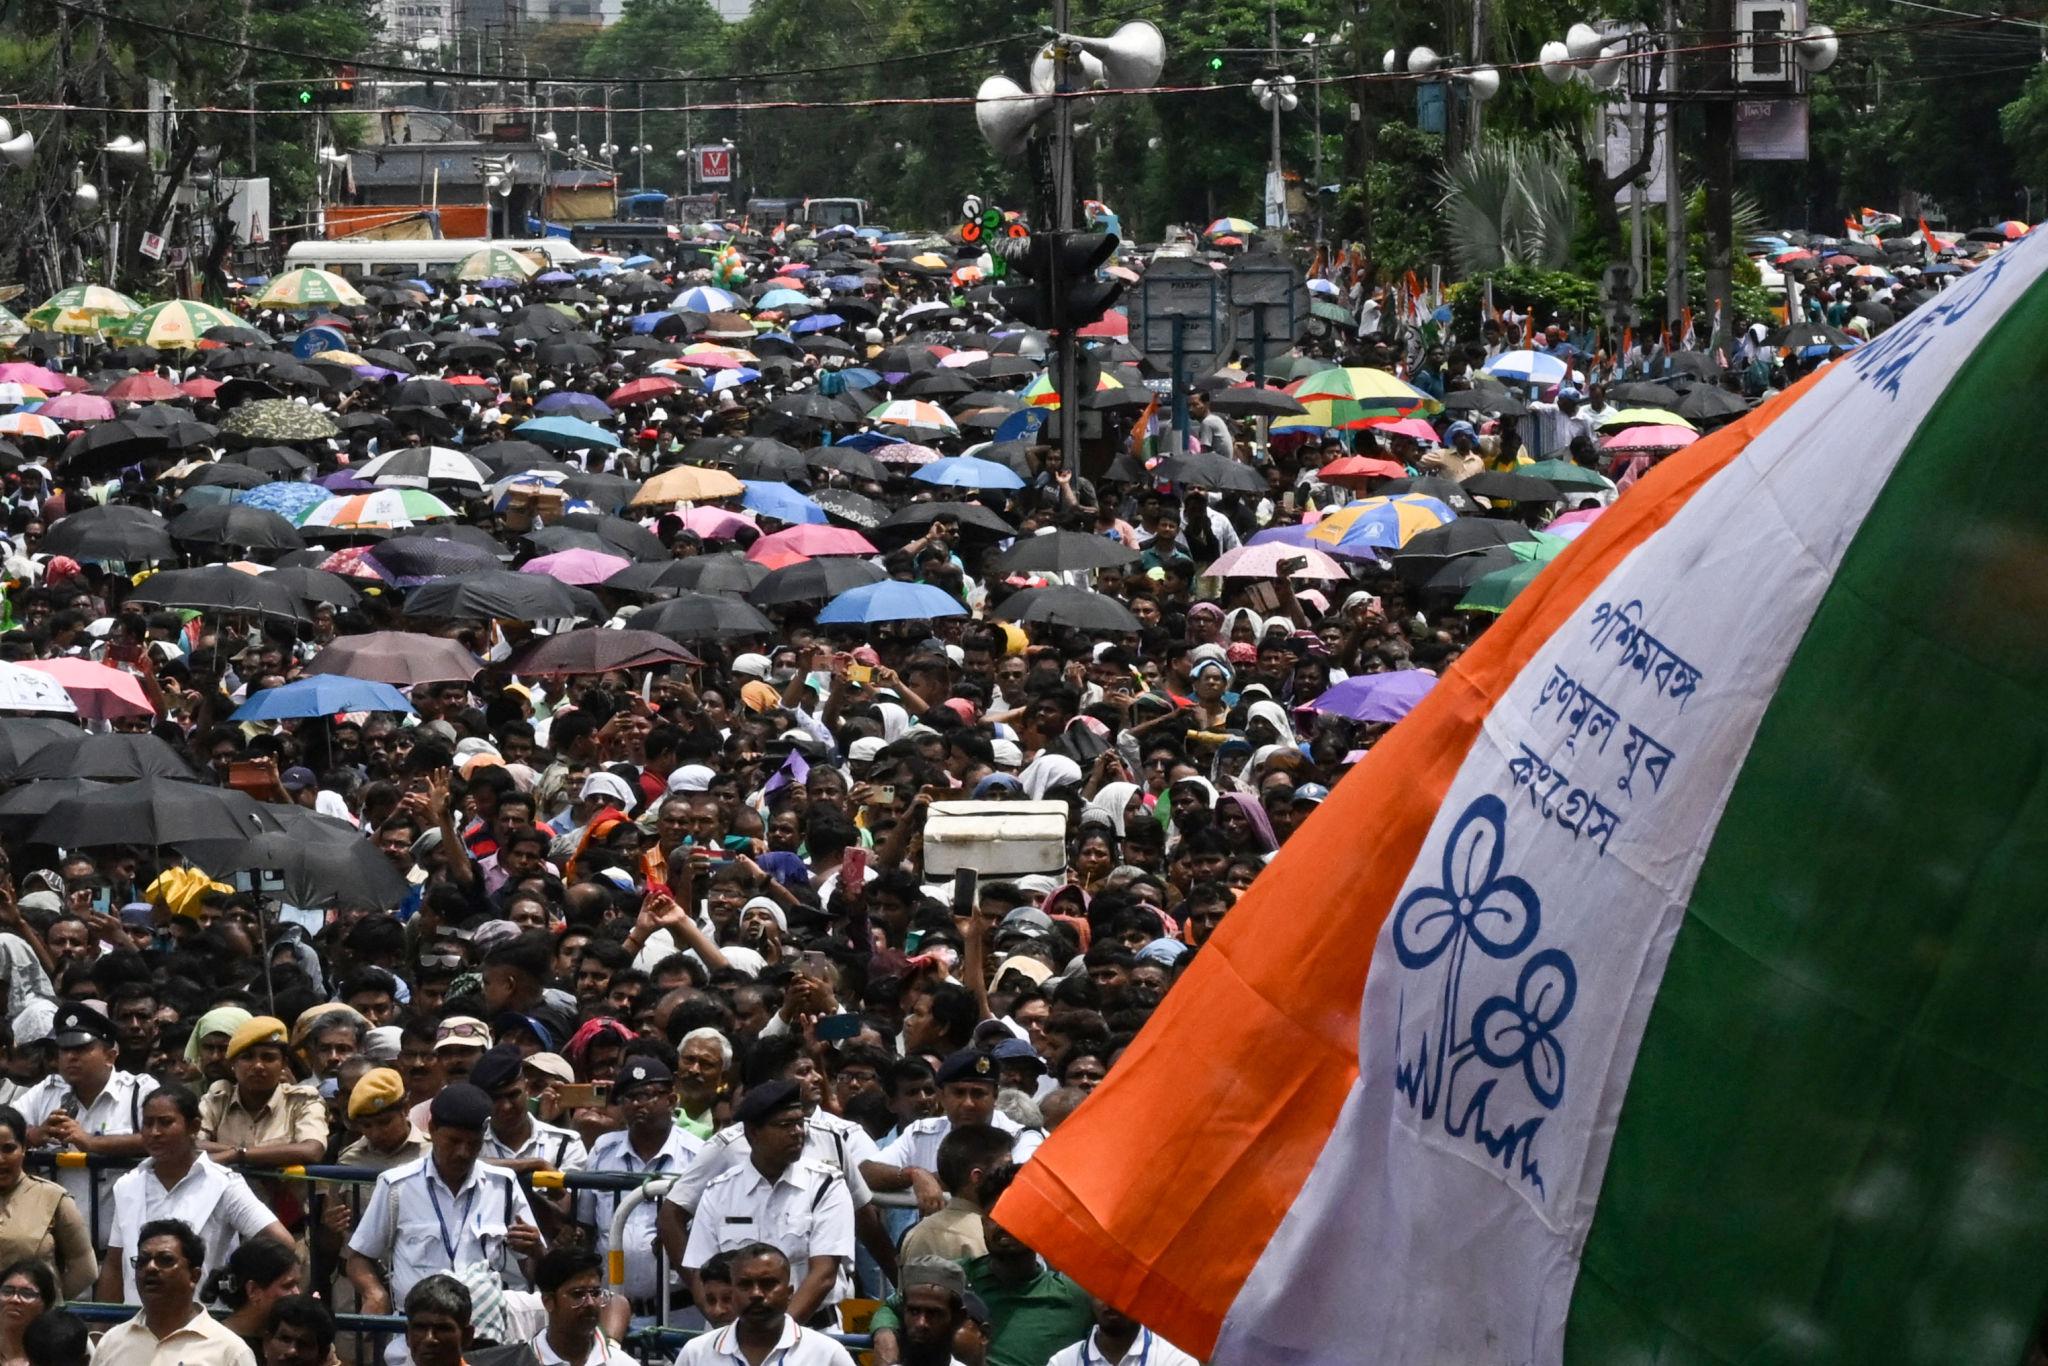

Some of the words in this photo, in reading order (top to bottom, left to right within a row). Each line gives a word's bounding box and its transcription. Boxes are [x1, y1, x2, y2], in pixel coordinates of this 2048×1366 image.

[708, 152, 722, 168] V
[1589, 599, 1703, 716] পশ্চিমবঙ্গ
[1531, 664, 1621, 757] তৃণমূল
[1616, 723, 1676, 800] যুব
[1508, 741, 1622, 858] কংগ্রেস
